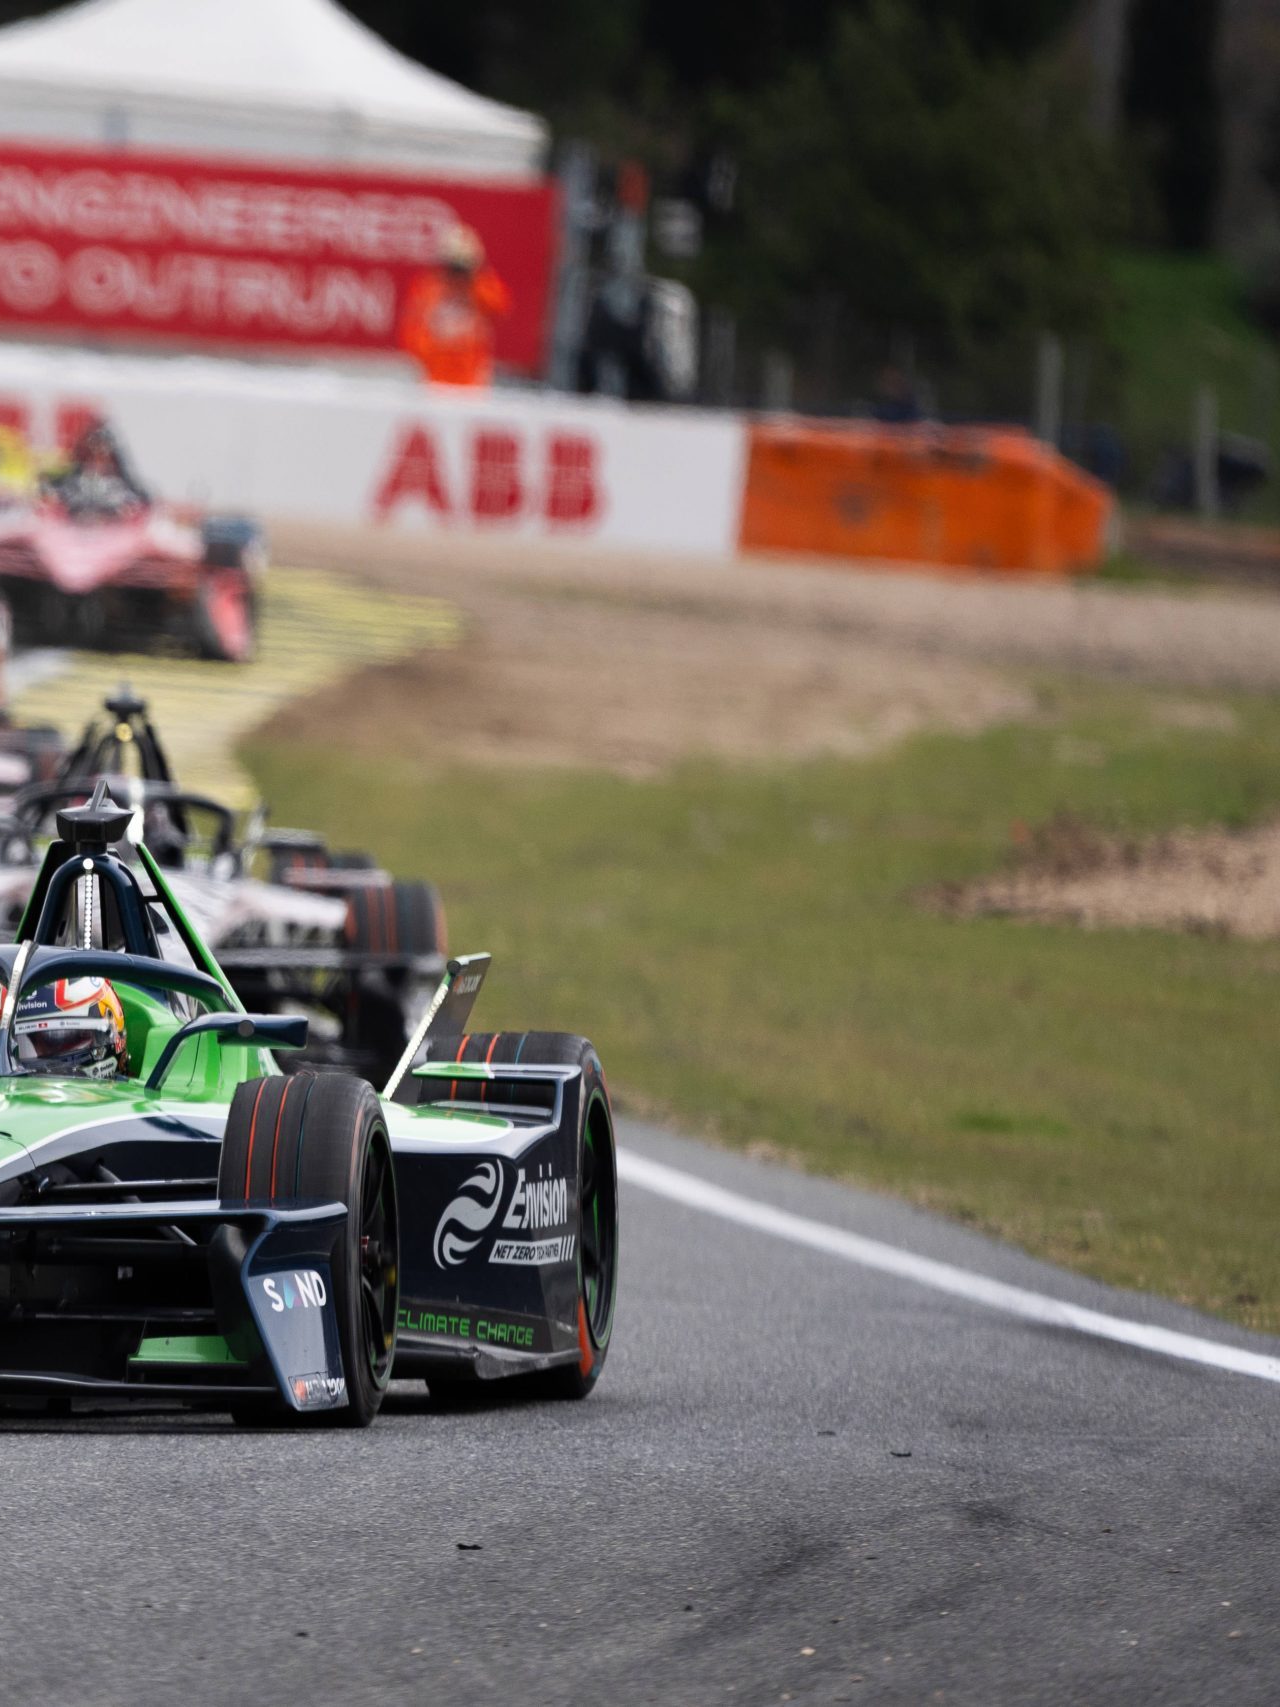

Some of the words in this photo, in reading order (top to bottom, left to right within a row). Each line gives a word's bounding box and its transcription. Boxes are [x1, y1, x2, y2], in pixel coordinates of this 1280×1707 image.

[64, 246, 396, 334] OUTRUN
[373, 424, 607, 532] ABB
[502, 1162, 567, 1229] Envision
[493, 1245, 514, 1260] NET
[512, 1244, 536, 1262] ZERO
[397, 1309, 470, 1337] CLIMATE
[476, 1320, 534, 1345] CHANGE
